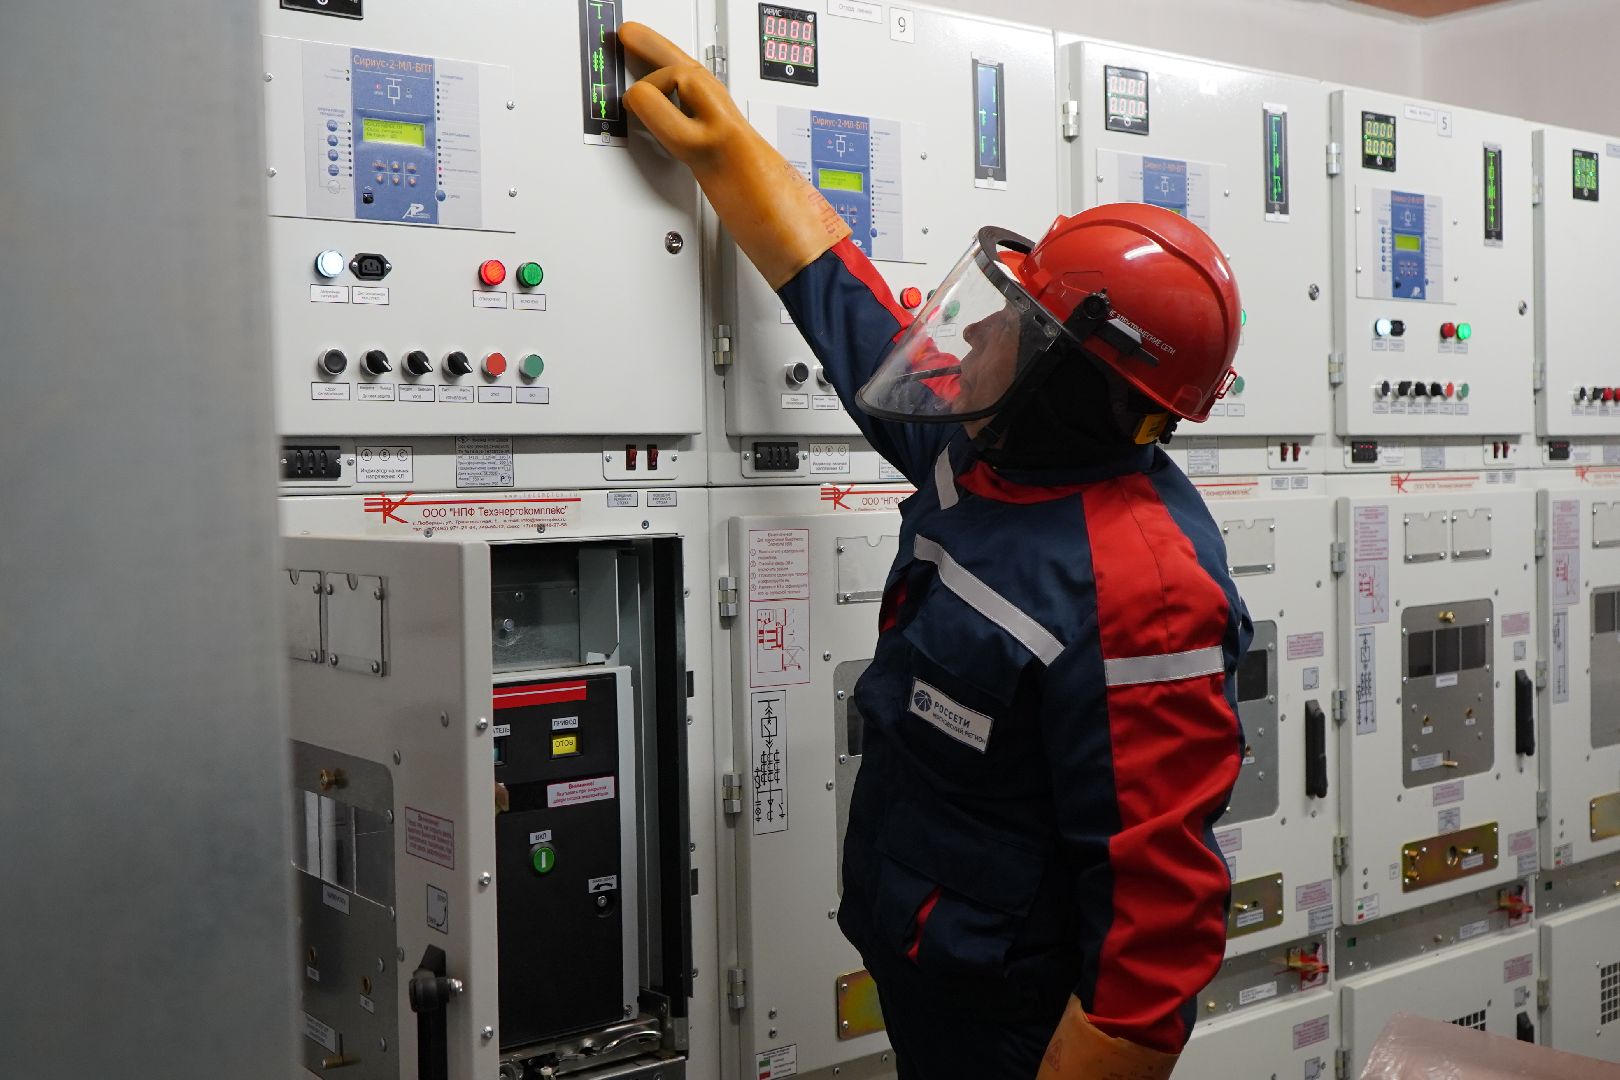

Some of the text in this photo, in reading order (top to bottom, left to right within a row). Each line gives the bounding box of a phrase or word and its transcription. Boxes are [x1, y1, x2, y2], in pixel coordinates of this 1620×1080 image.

[897, 16, 906, 33] 9
[353, 54, 433, 73] Сириус-2-МЛ-БПТ
[1442, 116, 1448, 130] 5
[1160, 343, 1176, 356] СЕТИ
[862, 496, 880, 505] ООО
[422, 508, 447, 518] ООО
[449, 507, 476, 517] "НПФ
[933, 701, 971, 728] РОССЕТИ
[553, 718, 577, 727] ПРИВОД
[932, 713, 986, 745] МОСКОВСКИЙ РЕГИОН
